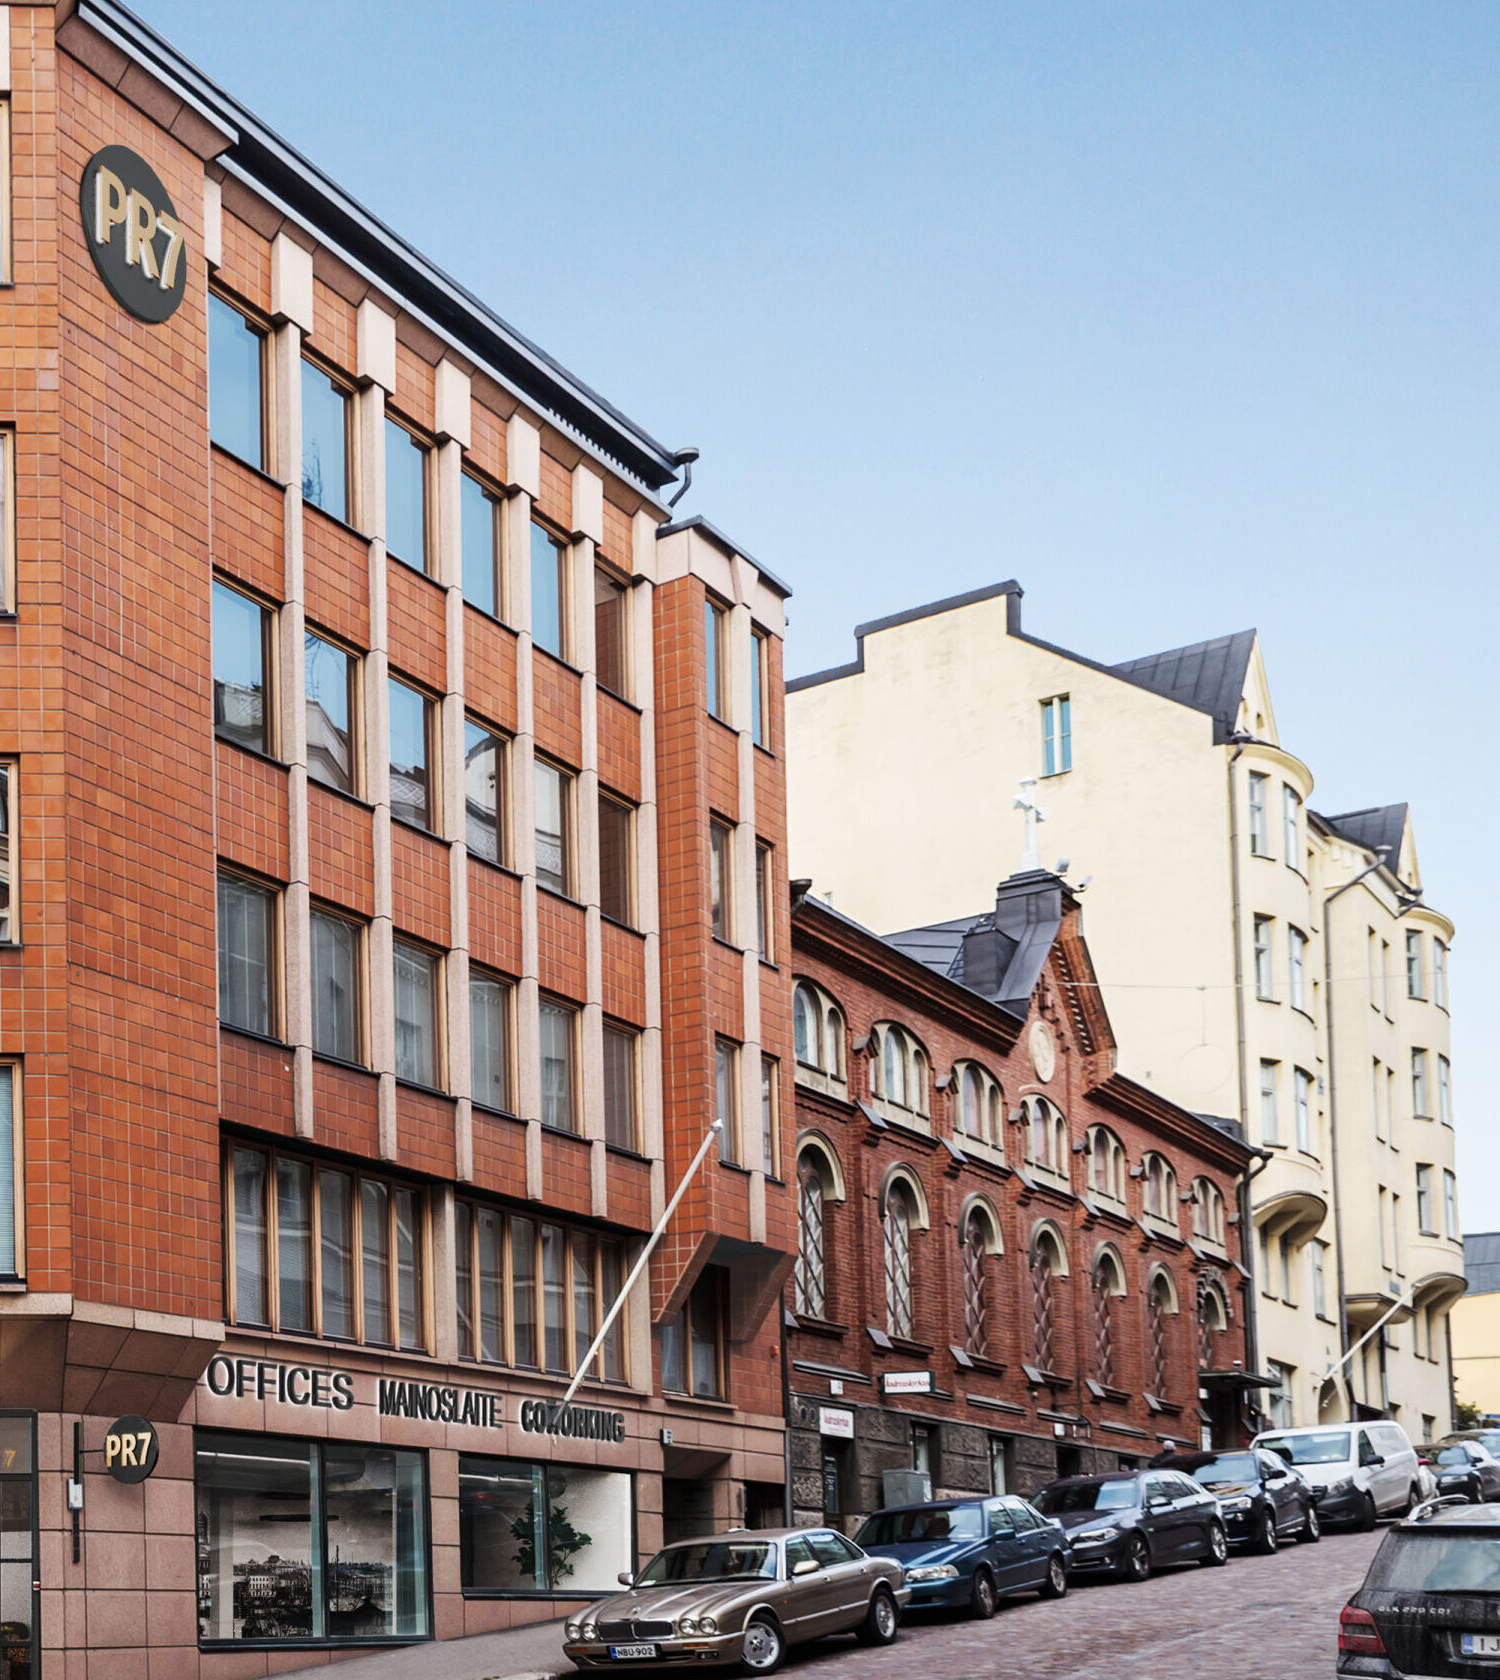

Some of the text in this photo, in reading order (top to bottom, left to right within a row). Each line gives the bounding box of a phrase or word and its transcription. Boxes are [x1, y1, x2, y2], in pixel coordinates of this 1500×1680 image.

[96, 165, 184, 289] PR7
[207, 1357, 354, 1410] OFFICES
[380, 1380, 503, 1428] MAINOSLAITE
[3, 1449, 17, 1468] 7
[106, 1432, 152, 1468] PR7
[618, 1647, 653, 1657] NBU-902
